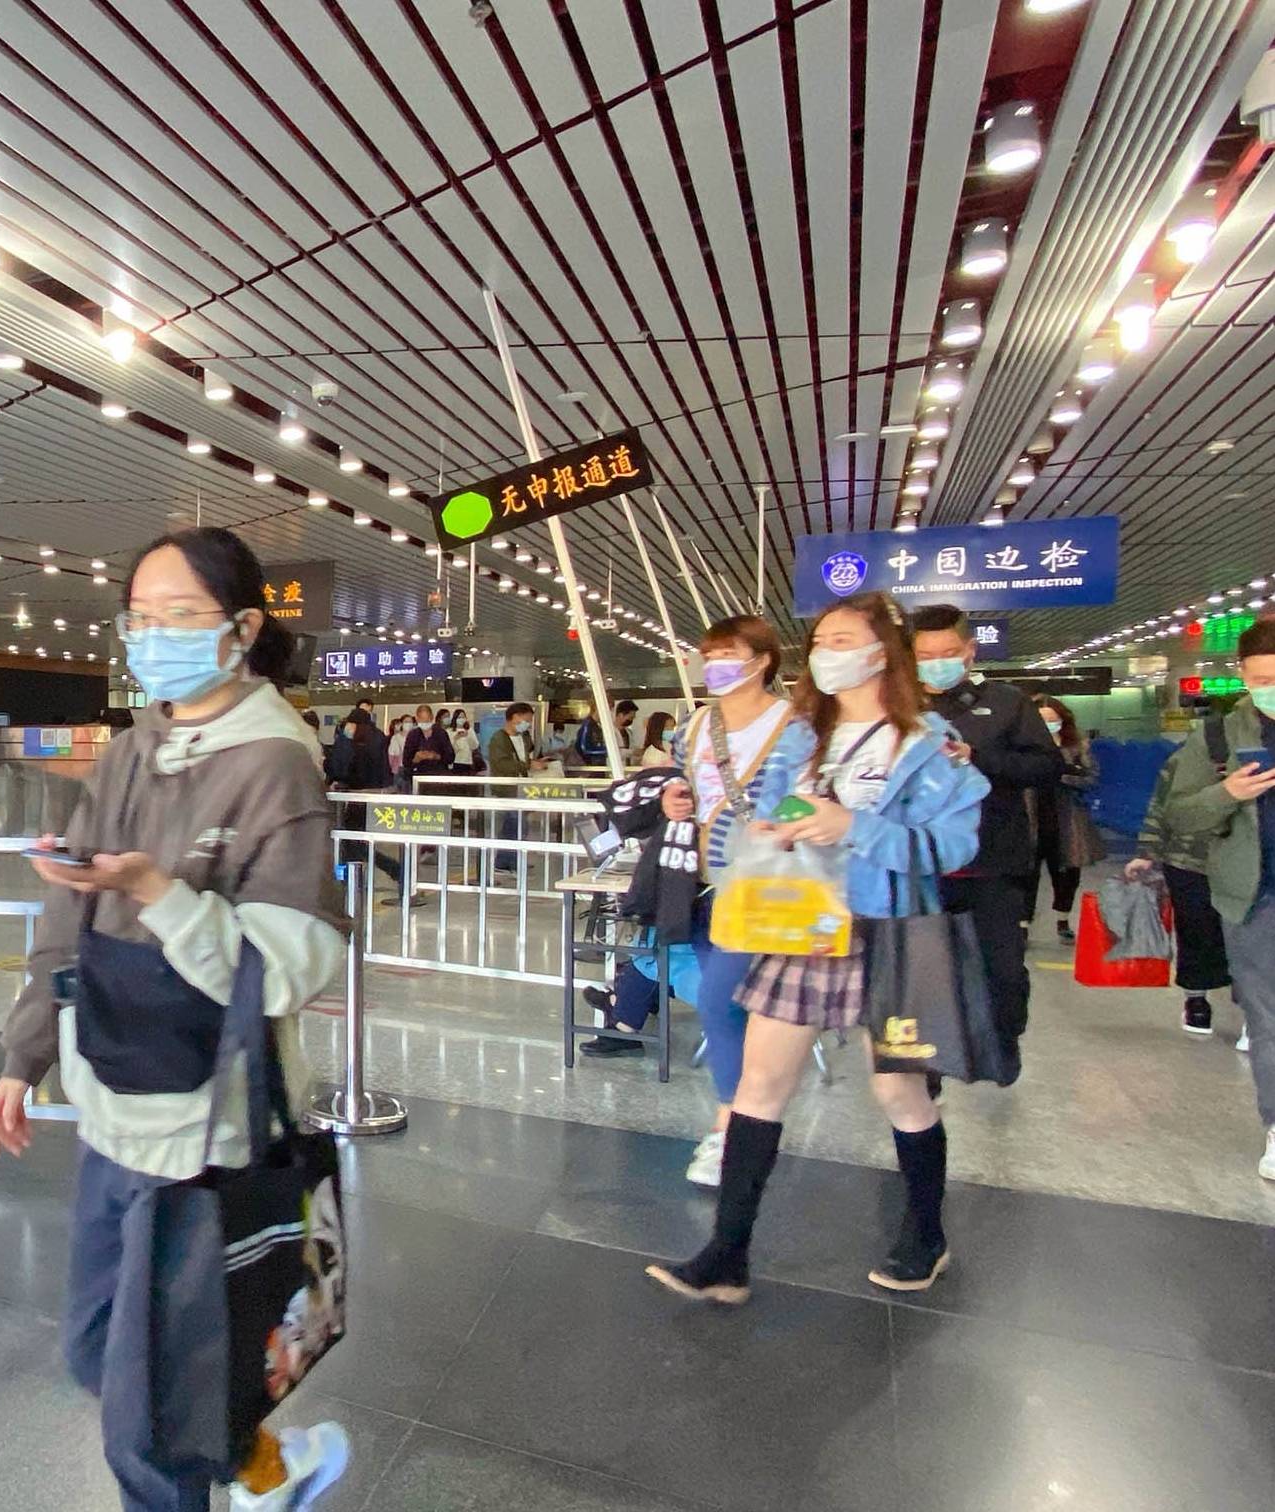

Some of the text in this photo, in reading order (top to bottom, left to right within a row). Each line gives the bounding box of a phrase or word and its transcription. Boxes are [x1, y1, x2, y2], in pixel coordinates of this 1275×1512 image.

[501, 445, 639, 517] 无申报通道
[888, 539, 1088, 581] 中国边检
[892, 577, 1083, 594] CHINA IMMIGRATION INSPECTION
[354, 648, 444, 668] 自助查验
